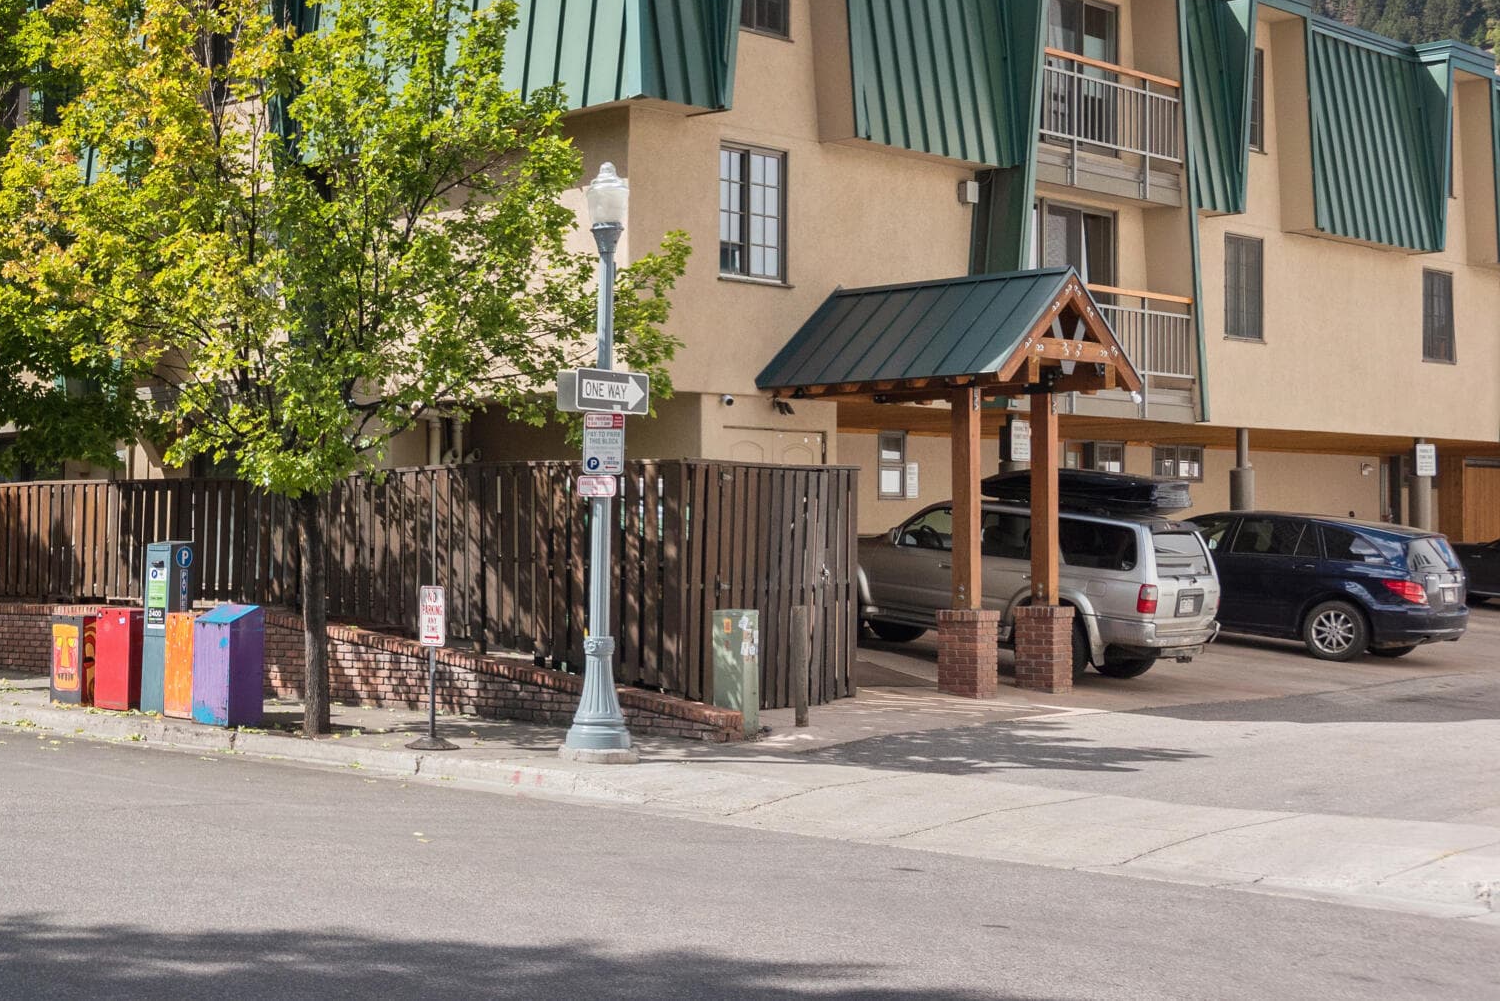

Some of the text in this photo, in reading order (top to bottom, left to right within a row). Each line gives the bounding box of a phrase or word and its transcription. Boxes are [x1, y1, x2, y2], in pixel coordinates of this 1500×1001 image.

[585, 381, 627, 400] ONE WAY
[590, 460, 597, 468] P
[182, 550, 189, 565] P
[428, 592, 437, 603] NO
[421, 604, 443, 615] PARKING
